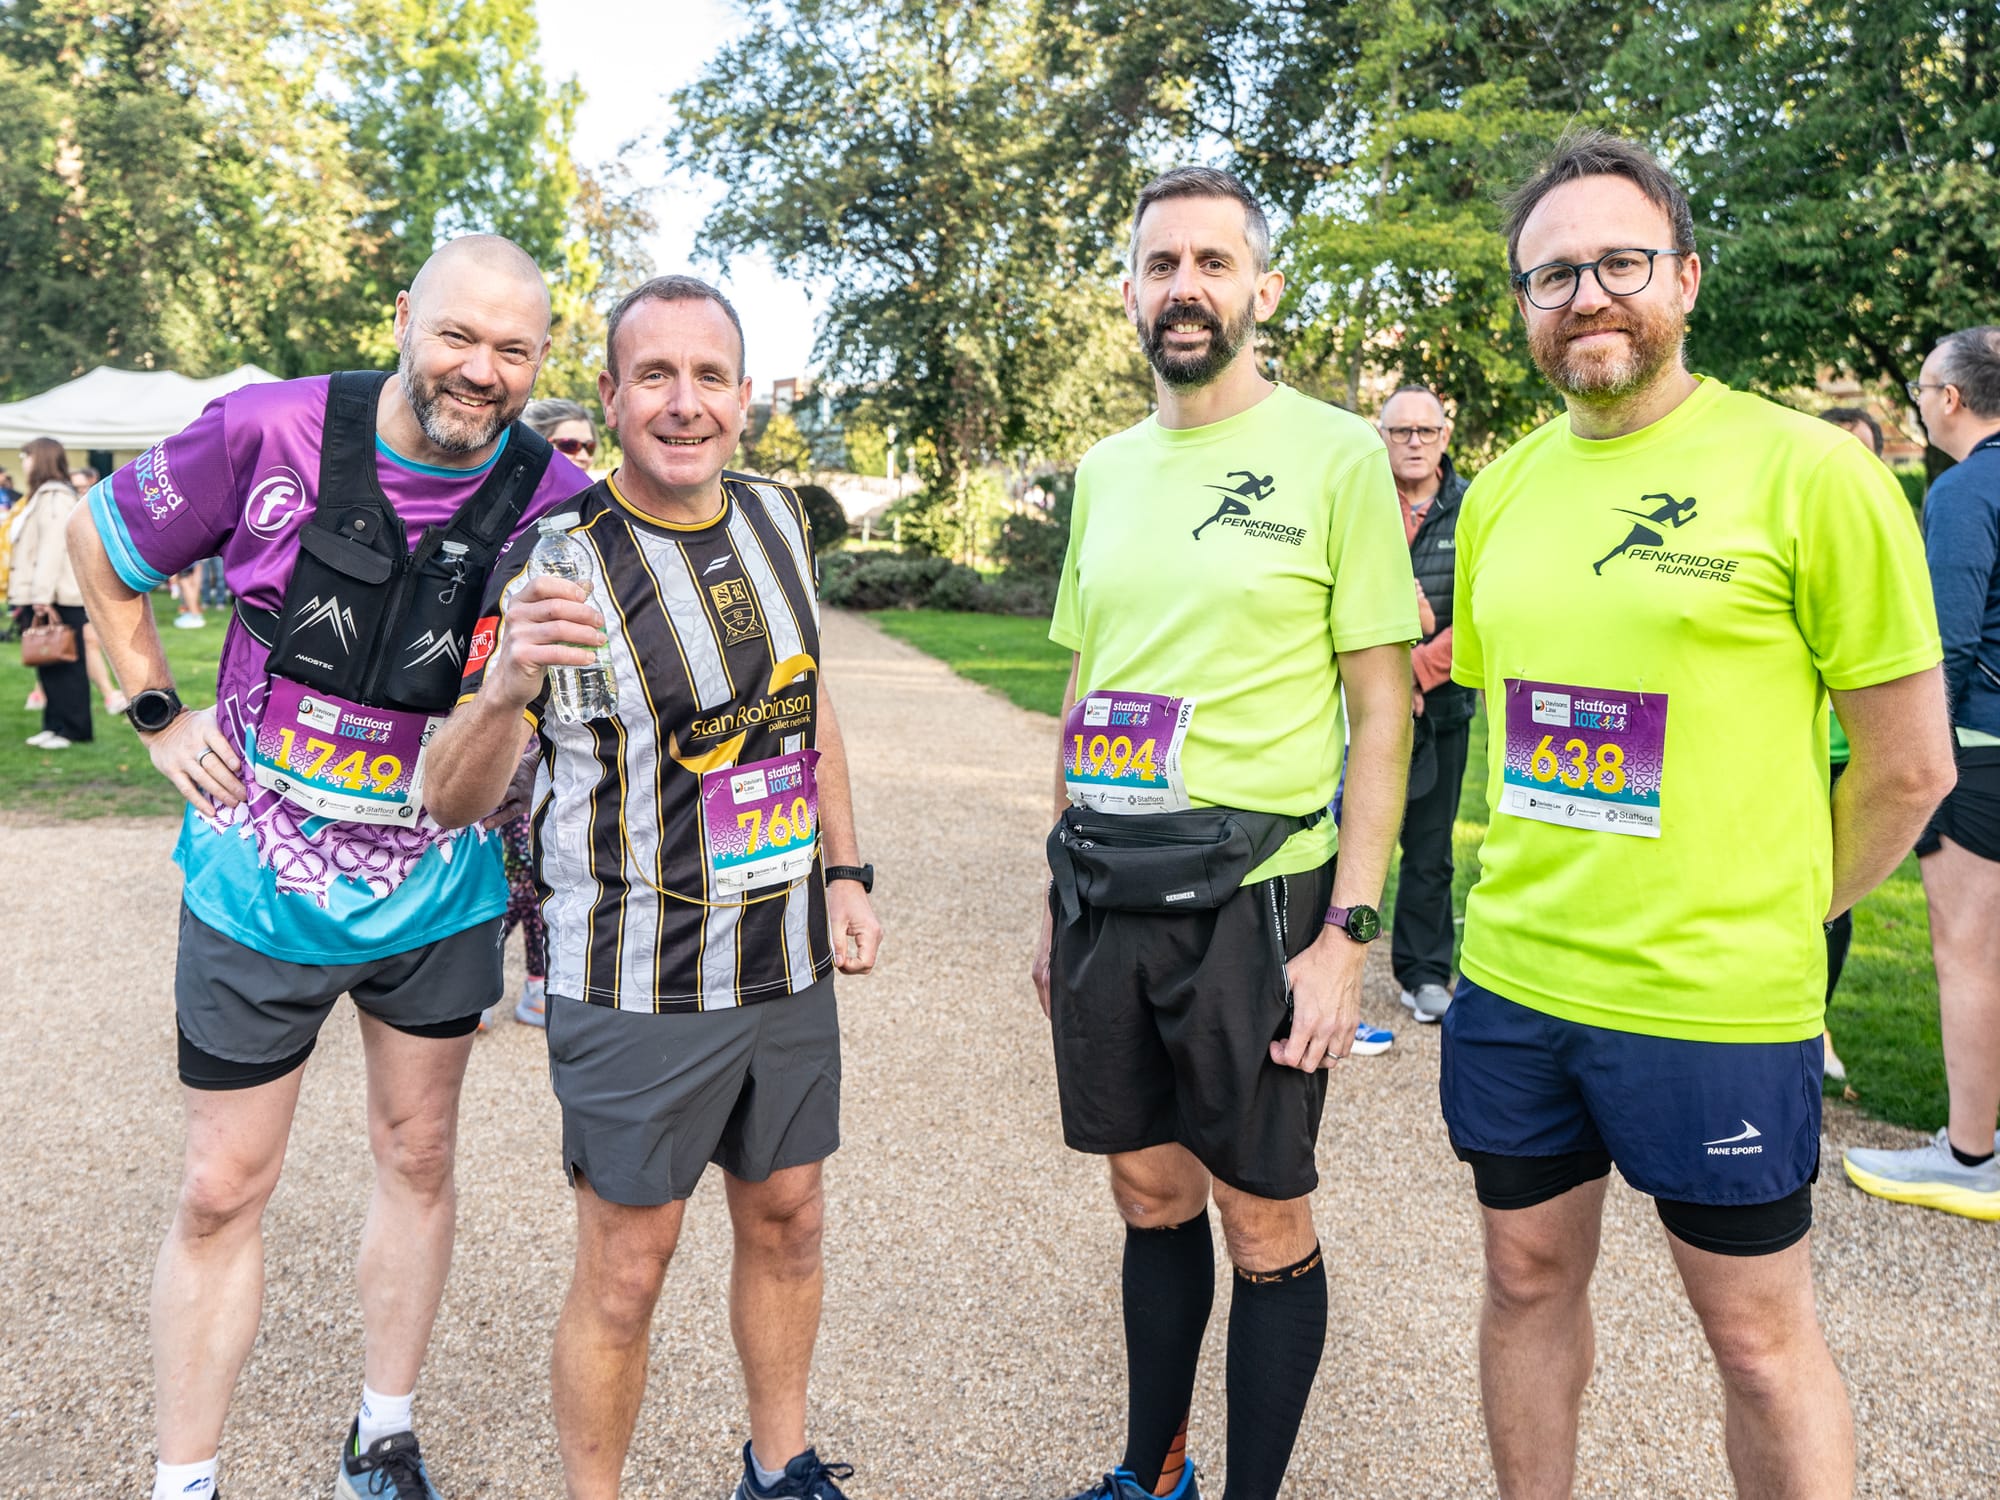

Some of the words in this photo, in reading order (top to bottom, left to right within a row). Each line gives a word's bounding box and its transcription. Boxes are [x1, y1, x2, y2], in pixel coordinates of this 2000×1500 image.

[1220, 517, 1307, 539] PENKRIDGE
[1243, 528, 1302, 546] RUNNERS
[1628, 549, 1740, 573] PENKRIDGE
[1655, 563, 1732, 583] RUNNERS
[295, 654, 335, 671] AMOSTEC
[1113, 700, 1151, 713] stafford
[1573, 699, 1628, 716] stafford
[341, 712, 393, 732] stafford
[690, 714, 734, 739] Stan
[736, 694, 811, 728] Robinson
[1111, 711, 1131, 726] 10K
[1177, 703, 1193, 730] 1994
[1573, 711, 1602, 729] 10K
[338, 722, 370, 741] 10K
[768, 719, 790, 734] pallet
[273, 727, 403, 794] 1749
[1072, 734, 1158, 781] 1994
[1530, 734, 1626, 794] 638
[767, 761, 801, 781] stafford
[768, 779, 791, 794] 10K
[736, 796, 812, 856] 760
[1619, 811, 1653, 823] Stafford
[1707, 1147, 1730, 1155] RANE
[1731, 1145, 1763, 1155] SPORTS
